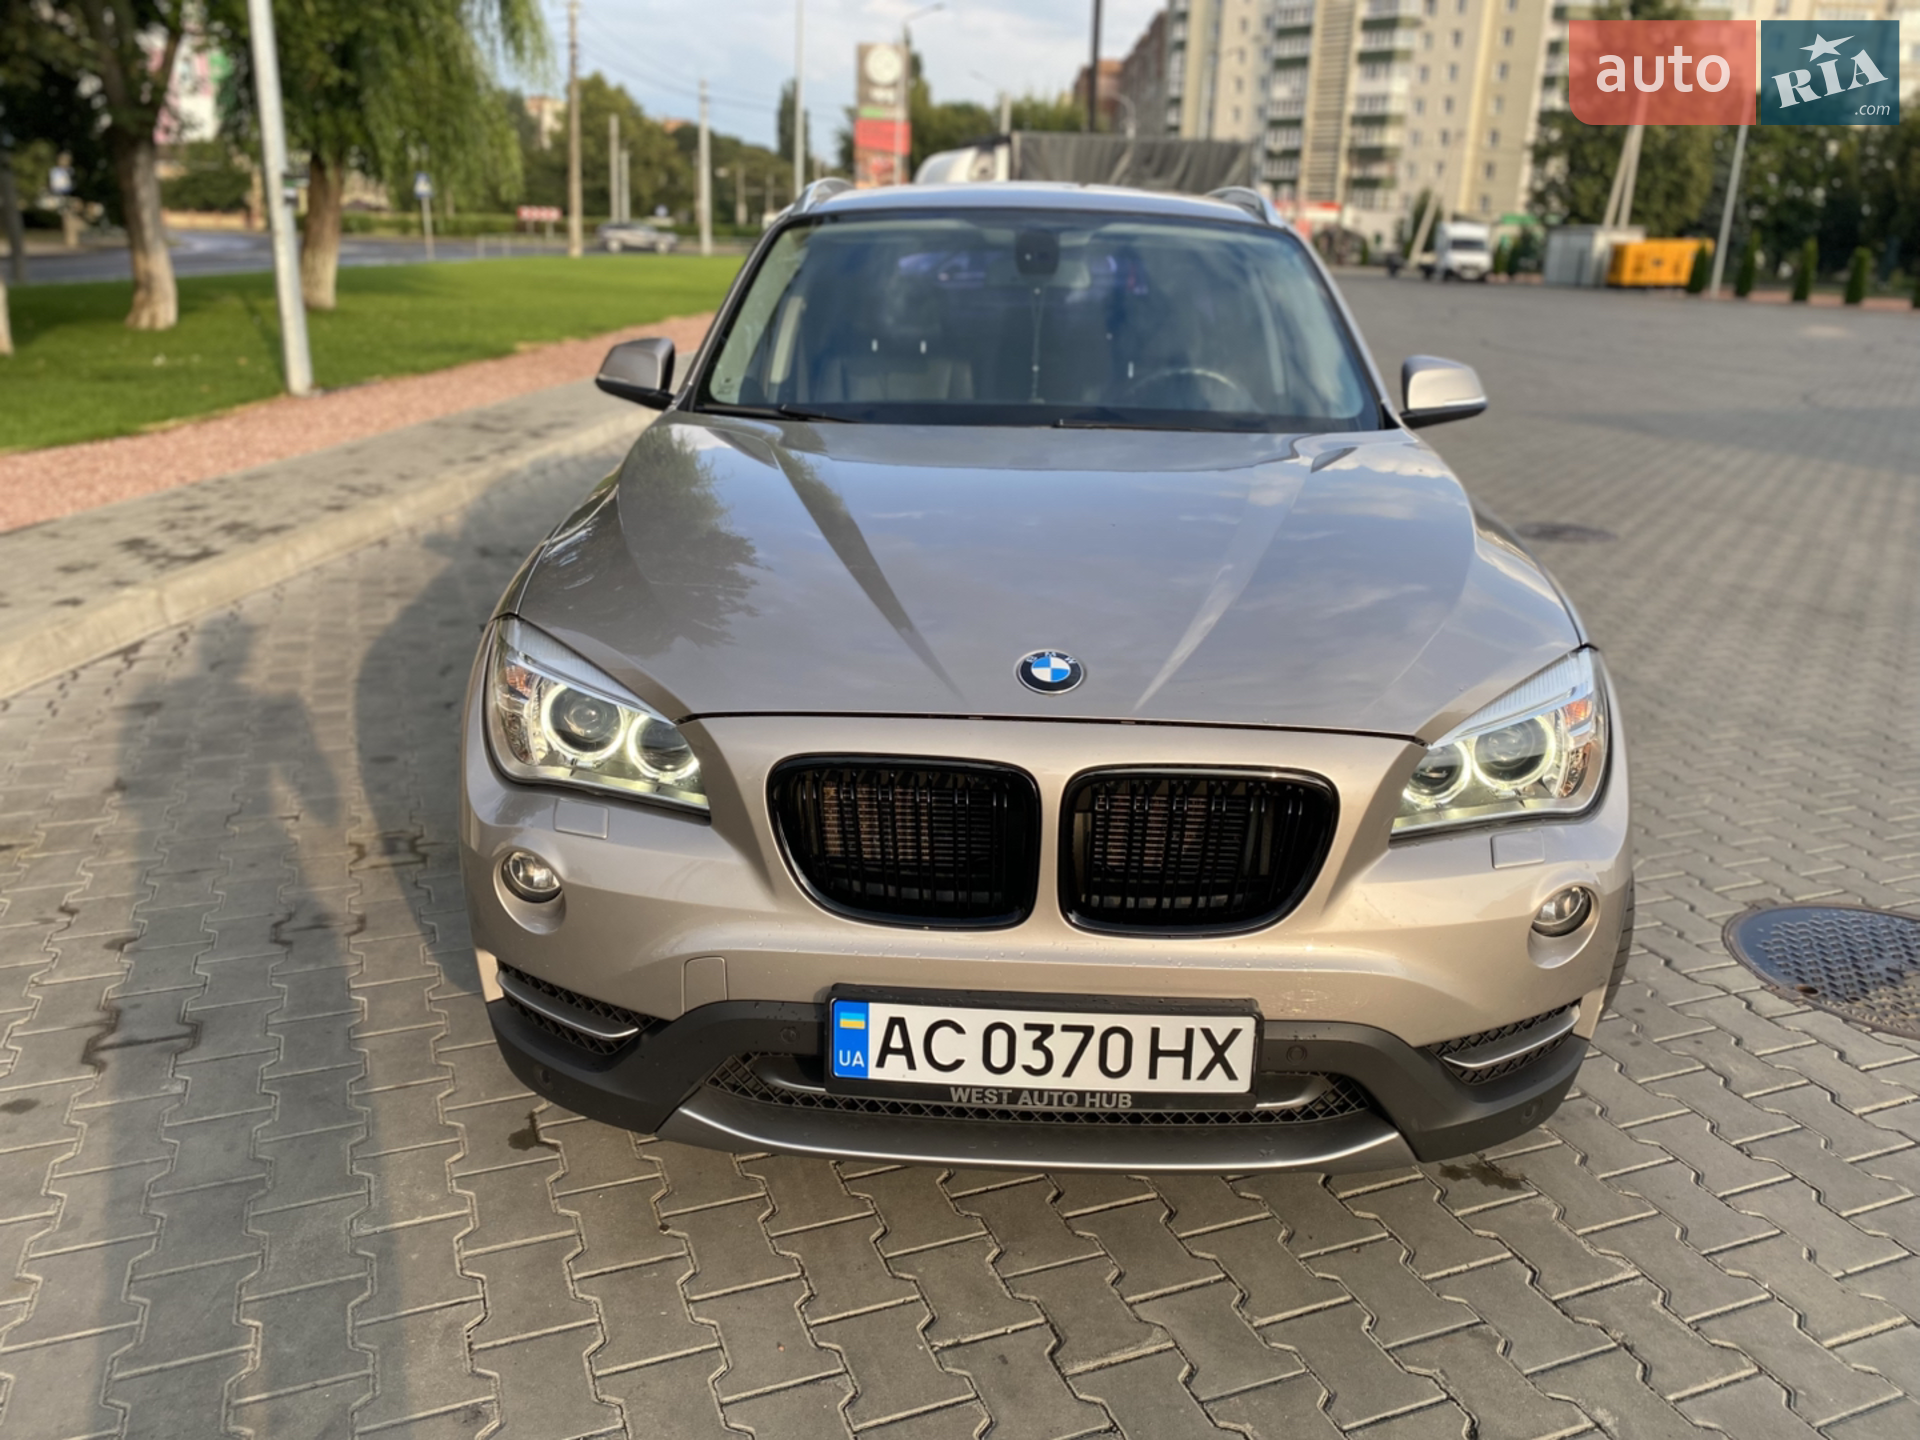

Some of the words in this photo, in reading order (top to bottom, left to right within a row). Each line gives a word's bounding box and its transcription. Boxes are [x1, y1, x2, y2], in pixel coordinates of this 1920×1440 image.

[839, 1050, 865, 1068] UA
[876, 1016, 967, 1072] AC
[982, 1021, 1133, 1079] 0370
[1148, 1027, 1243, 1081] HX
[950, 1087, 1011, 1104] WEST
[1018, 1090, 1079, 1107] AUTO
[1085, 1092, 1132, 1108] HUB
